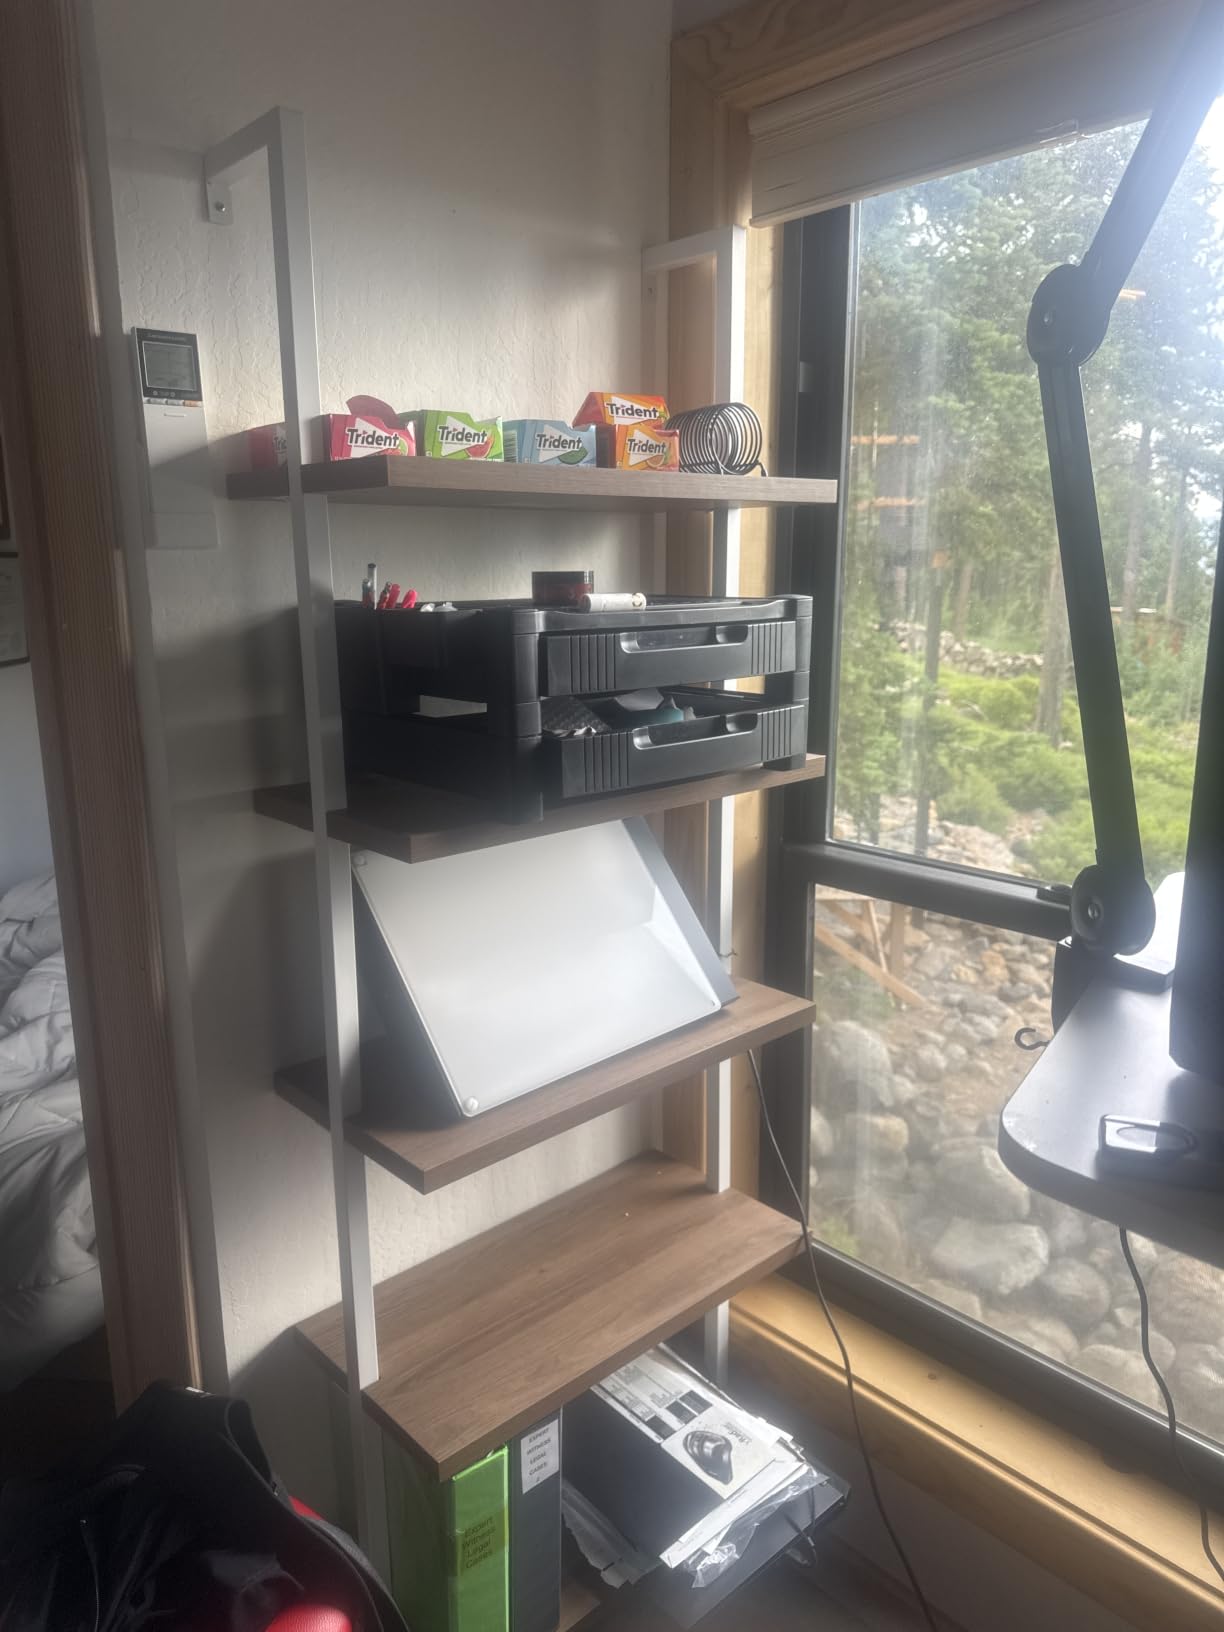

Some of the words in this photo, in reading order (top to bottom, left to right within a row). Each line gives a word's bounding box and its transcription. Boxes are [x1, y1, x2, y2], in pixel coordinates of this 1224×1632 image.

[606, 403, 658, 418] Trident
[347, 428, 399, 447] Trident
[438, 426, 488, 443] Trident
[536, 433, 582, 449] Trident
[627, 438, 666, 454] Trident
